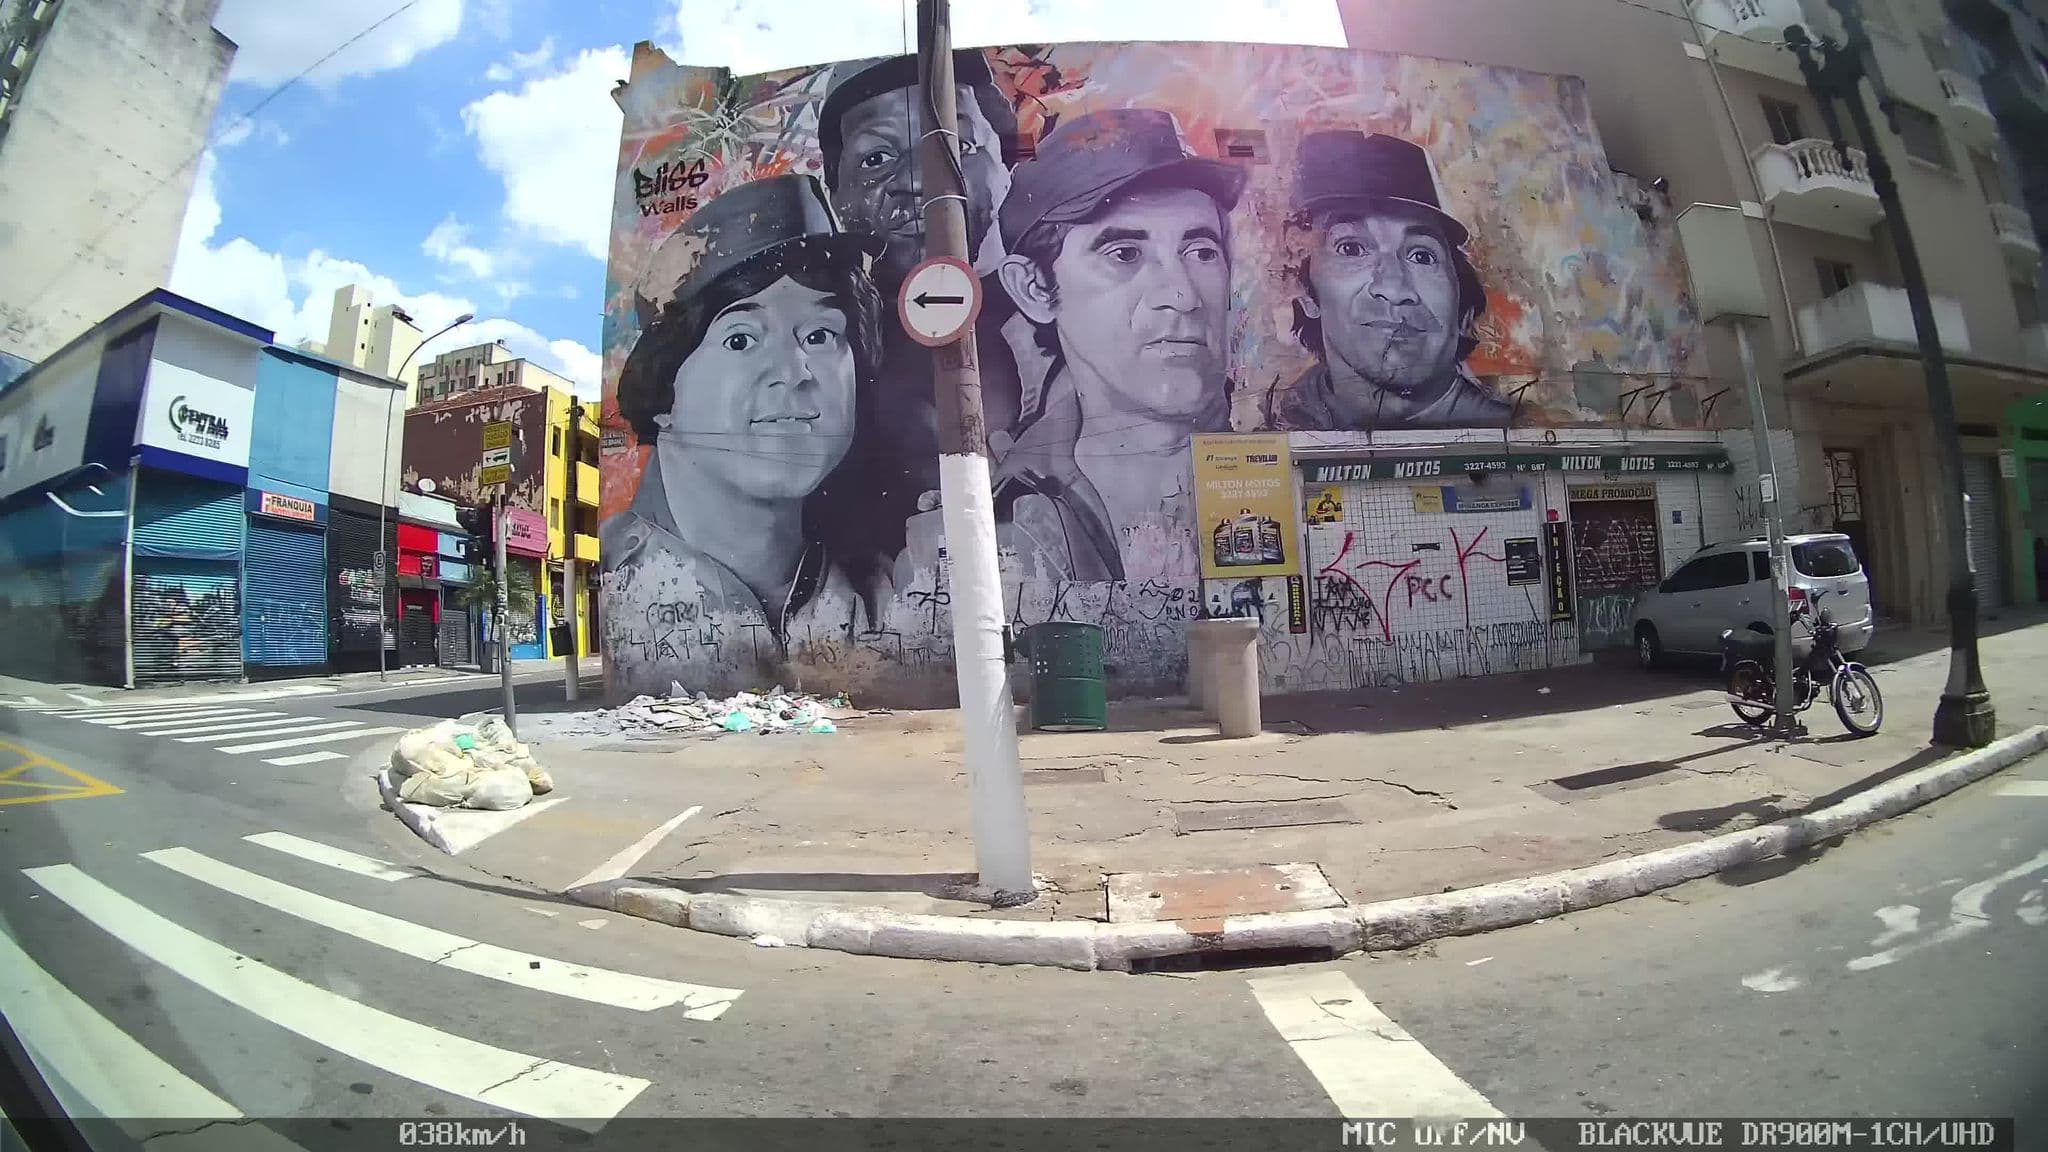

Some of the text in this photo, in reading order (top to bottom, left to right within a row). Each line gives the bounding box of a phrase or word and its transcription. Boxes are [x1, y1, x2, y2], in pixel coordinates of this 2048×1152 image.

[1561, 455, 1601, 470] MILTON
[1620, 457, 1656, 471] MOTOS
[1316, 464, 1372, 482] MILTON
[1395, 461, 1441, 479] MOTOS
[1570, 489, 1600, 500] MEGA
[271, 496, 313, 513] FRANQUIA
